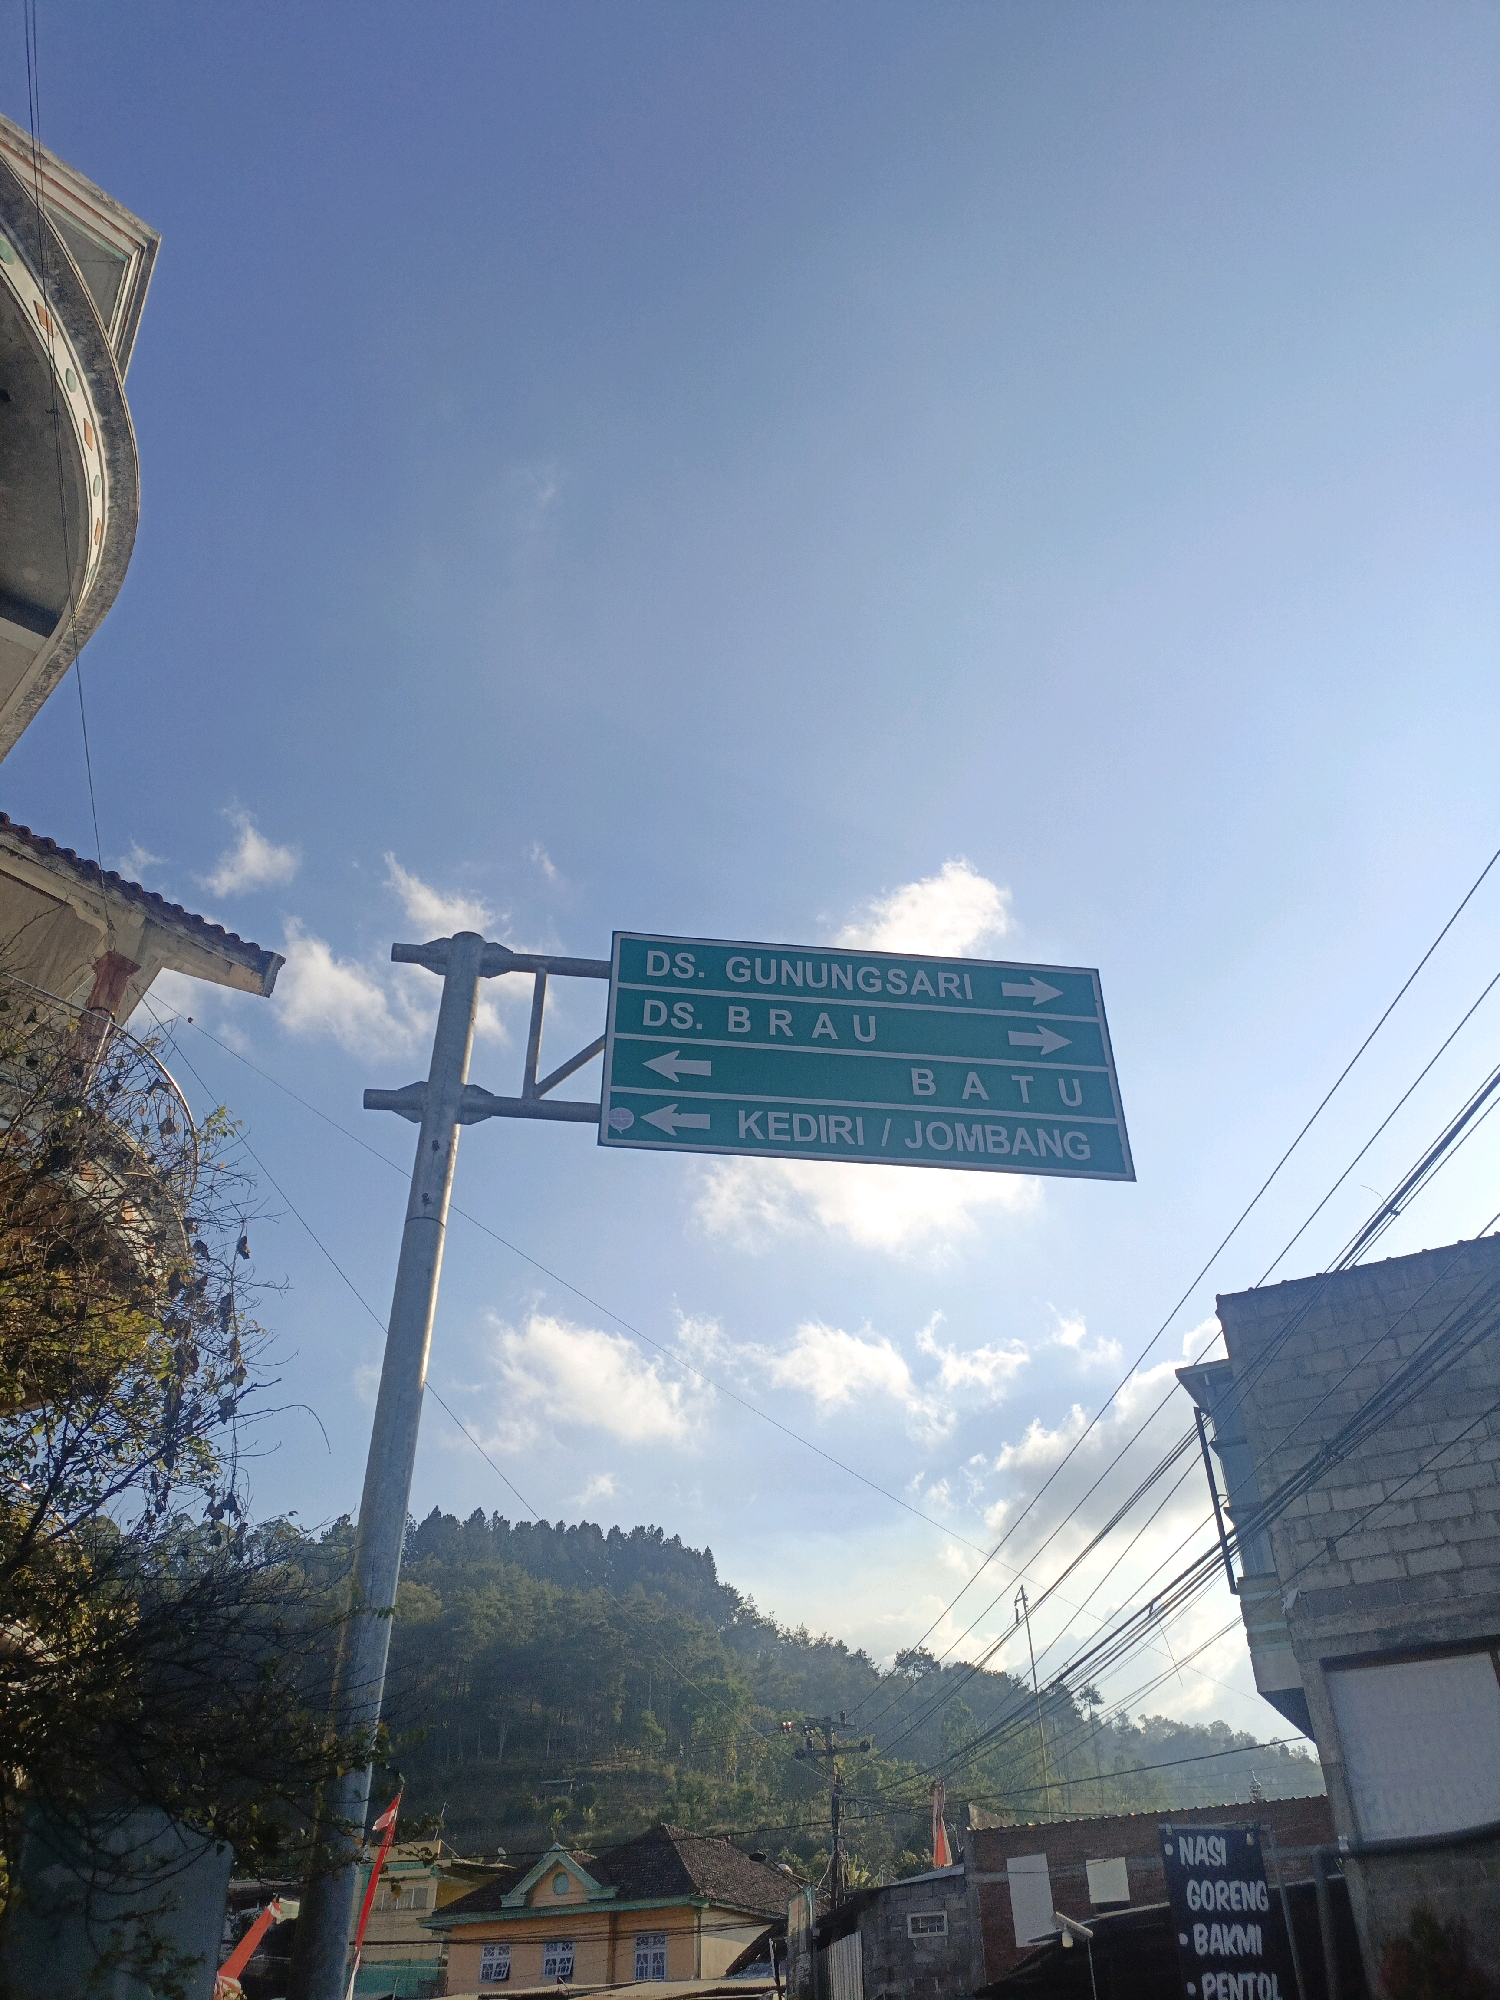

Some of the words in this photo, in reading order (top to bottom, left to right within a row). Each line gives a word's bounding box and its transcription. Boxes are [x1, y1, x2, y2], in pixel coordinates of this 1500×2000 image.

[645, 949, 705, 979] DS.
[725, 955, 972, 1000] GUNUNGSARI
[642, 999, 703, 1030] DS.
[738, 1109, 864, 1146] KEDIRI
[904, 1119, 1091, 1161] JOMBANG
[1178, 1835, 1227, 1867] NASI
[1186, 1879, 1269, 1911] GORENG
[1193, 1923, 1263, 1956] BAKMI
[1201, 1972, 1283, 2000] PENTOL
